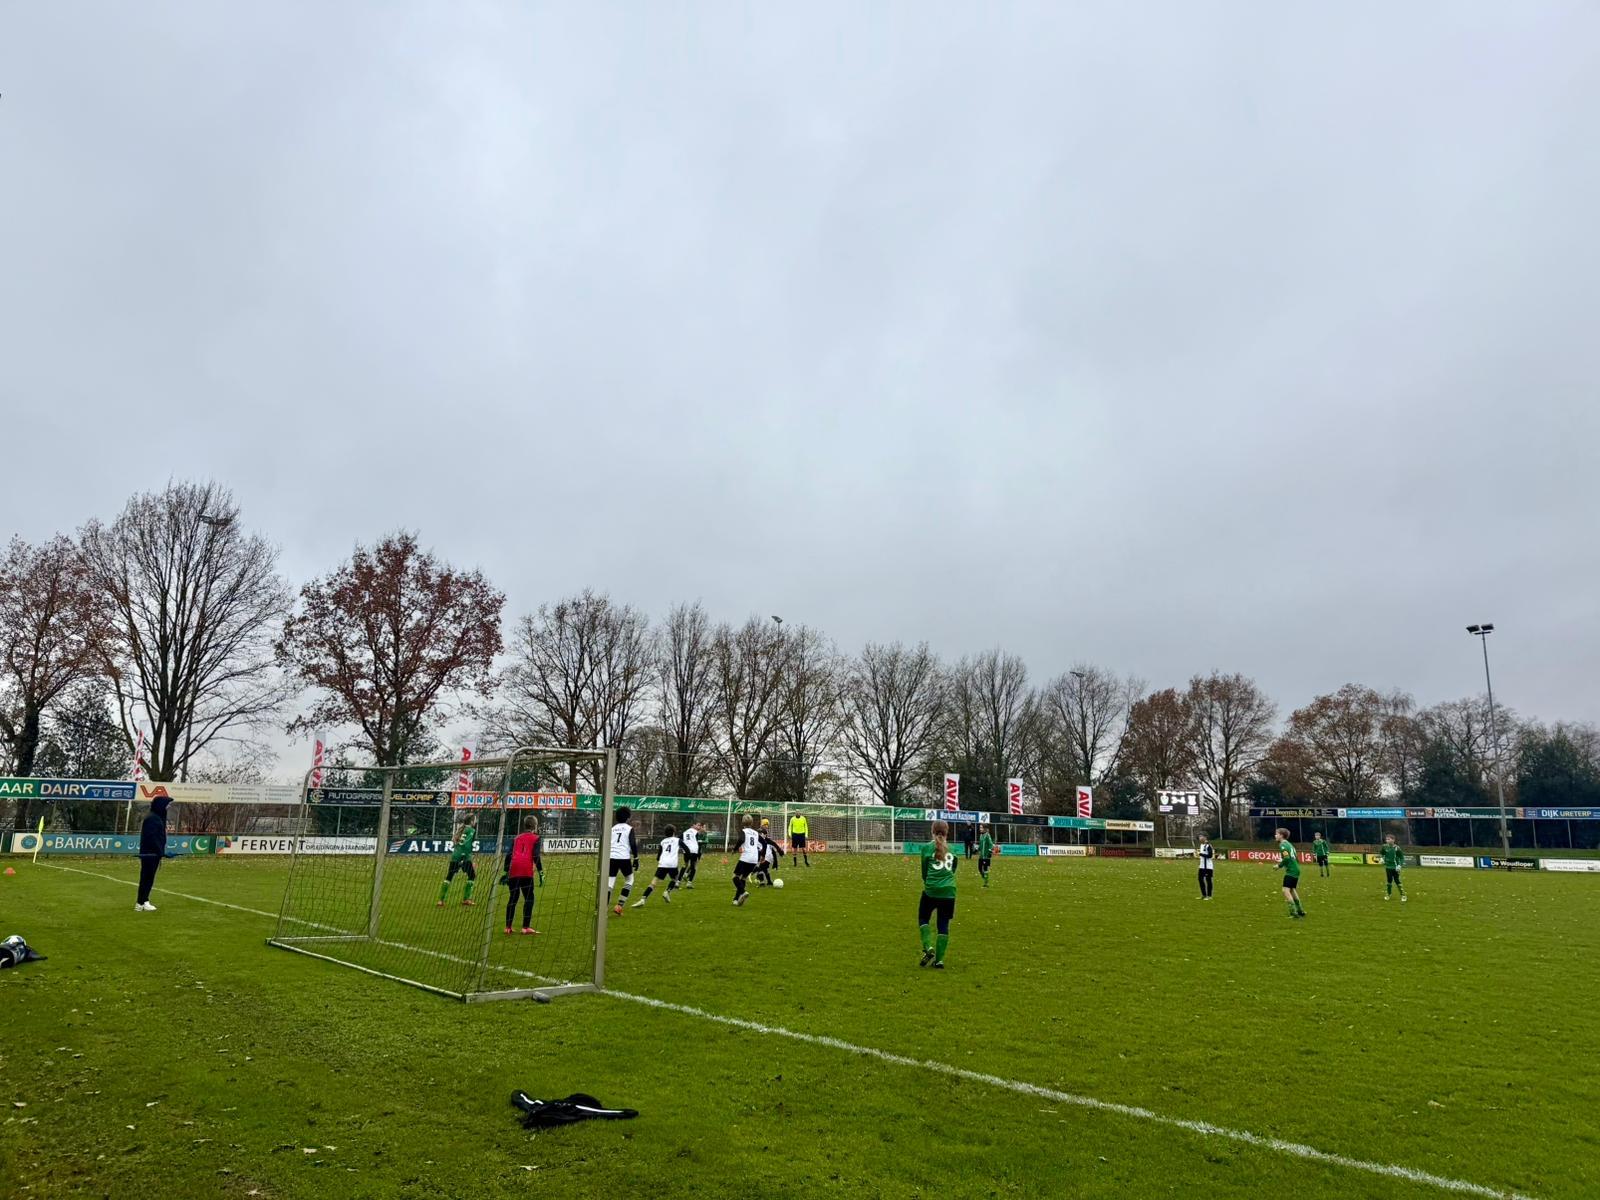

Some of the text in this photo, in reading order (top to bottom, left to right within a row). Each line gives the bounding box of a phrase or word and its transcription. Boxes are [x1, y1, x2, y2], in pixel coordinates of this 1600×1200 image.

[0, 783, 88, 795] AAR DAIRY
[1078, 791, 1091, 818] AVI
[1541, 809, 1559, 817] DIJK
[54, 837, 113, 849] BARKAT
[616, 832, 623, 843] 7
[749, 836, 755, 846] 8
[408, 840, 480, 852] ALTRS
[548, 839, 577, 849] MAND
[665, 844, 672, 853] 4
